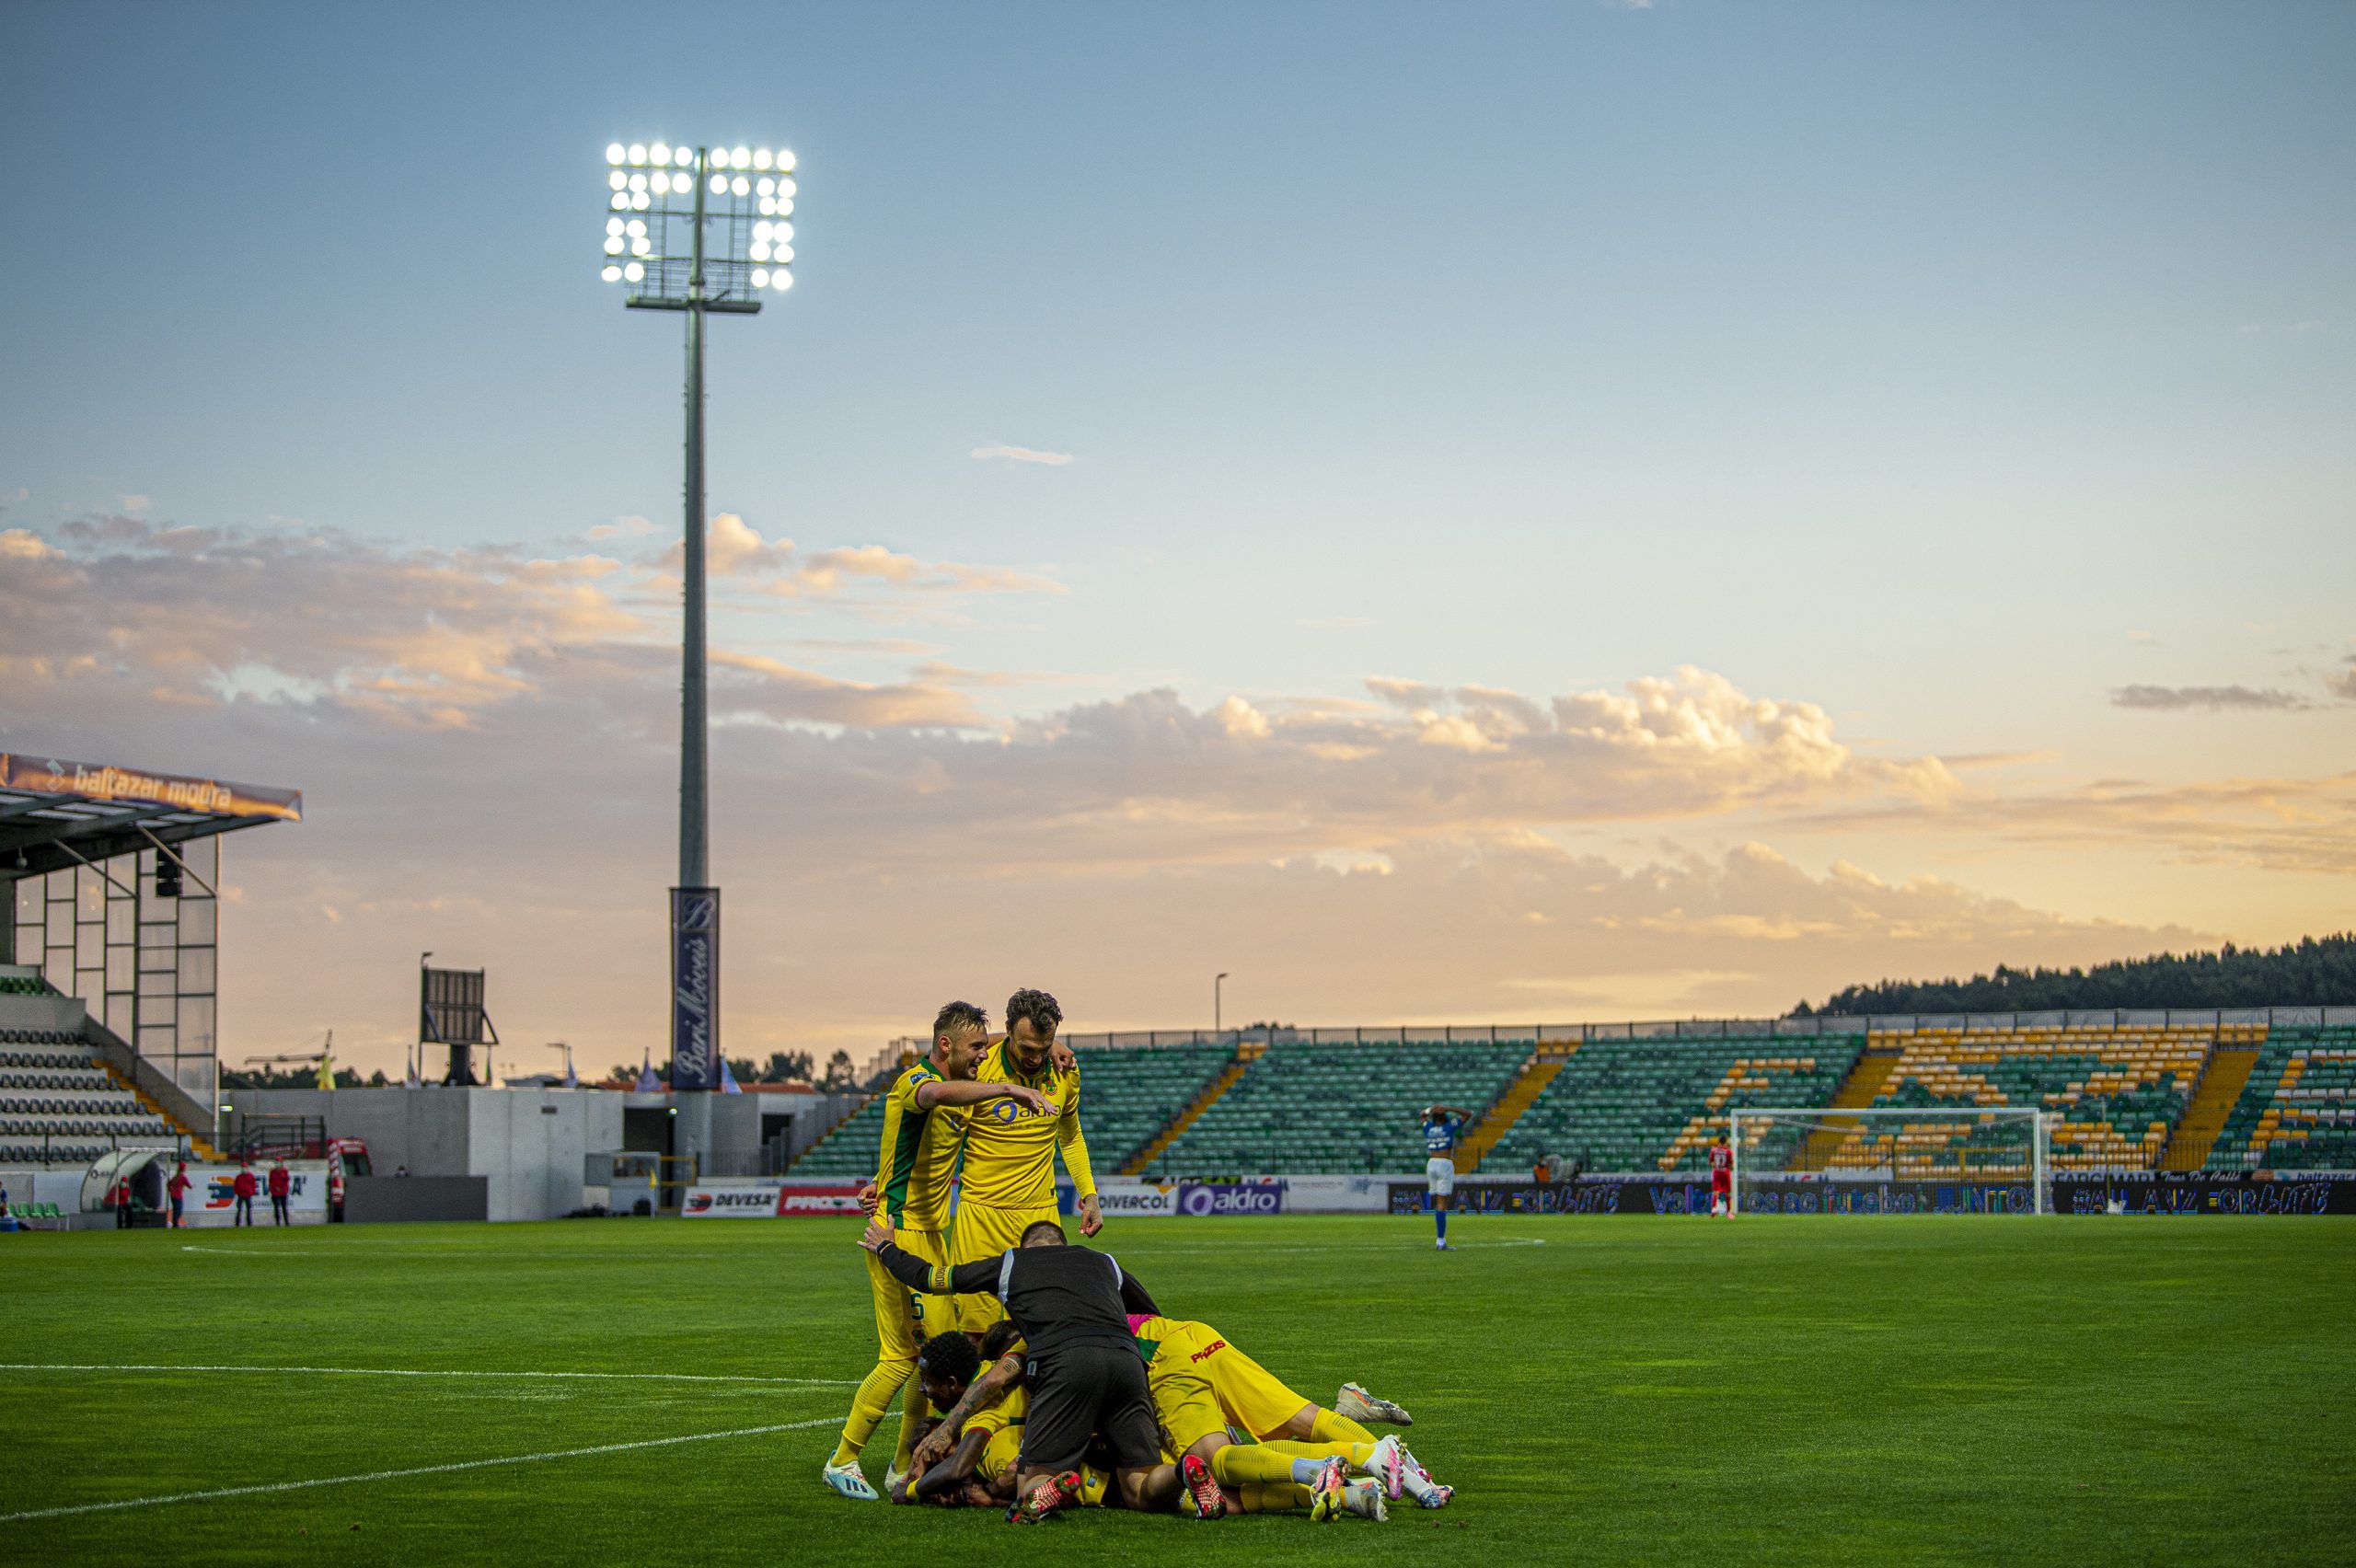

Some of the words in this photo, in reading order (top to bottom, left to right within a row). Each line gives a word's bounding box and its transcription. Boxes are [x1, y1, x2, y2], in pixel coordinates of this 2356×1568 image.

[75, 764, 165, 800] baltazar
[167, 779, 232, 811] moura
[715, 1193, 772, 1206] DEVESA
[1214, 1187, 1276, 1211] aldro
